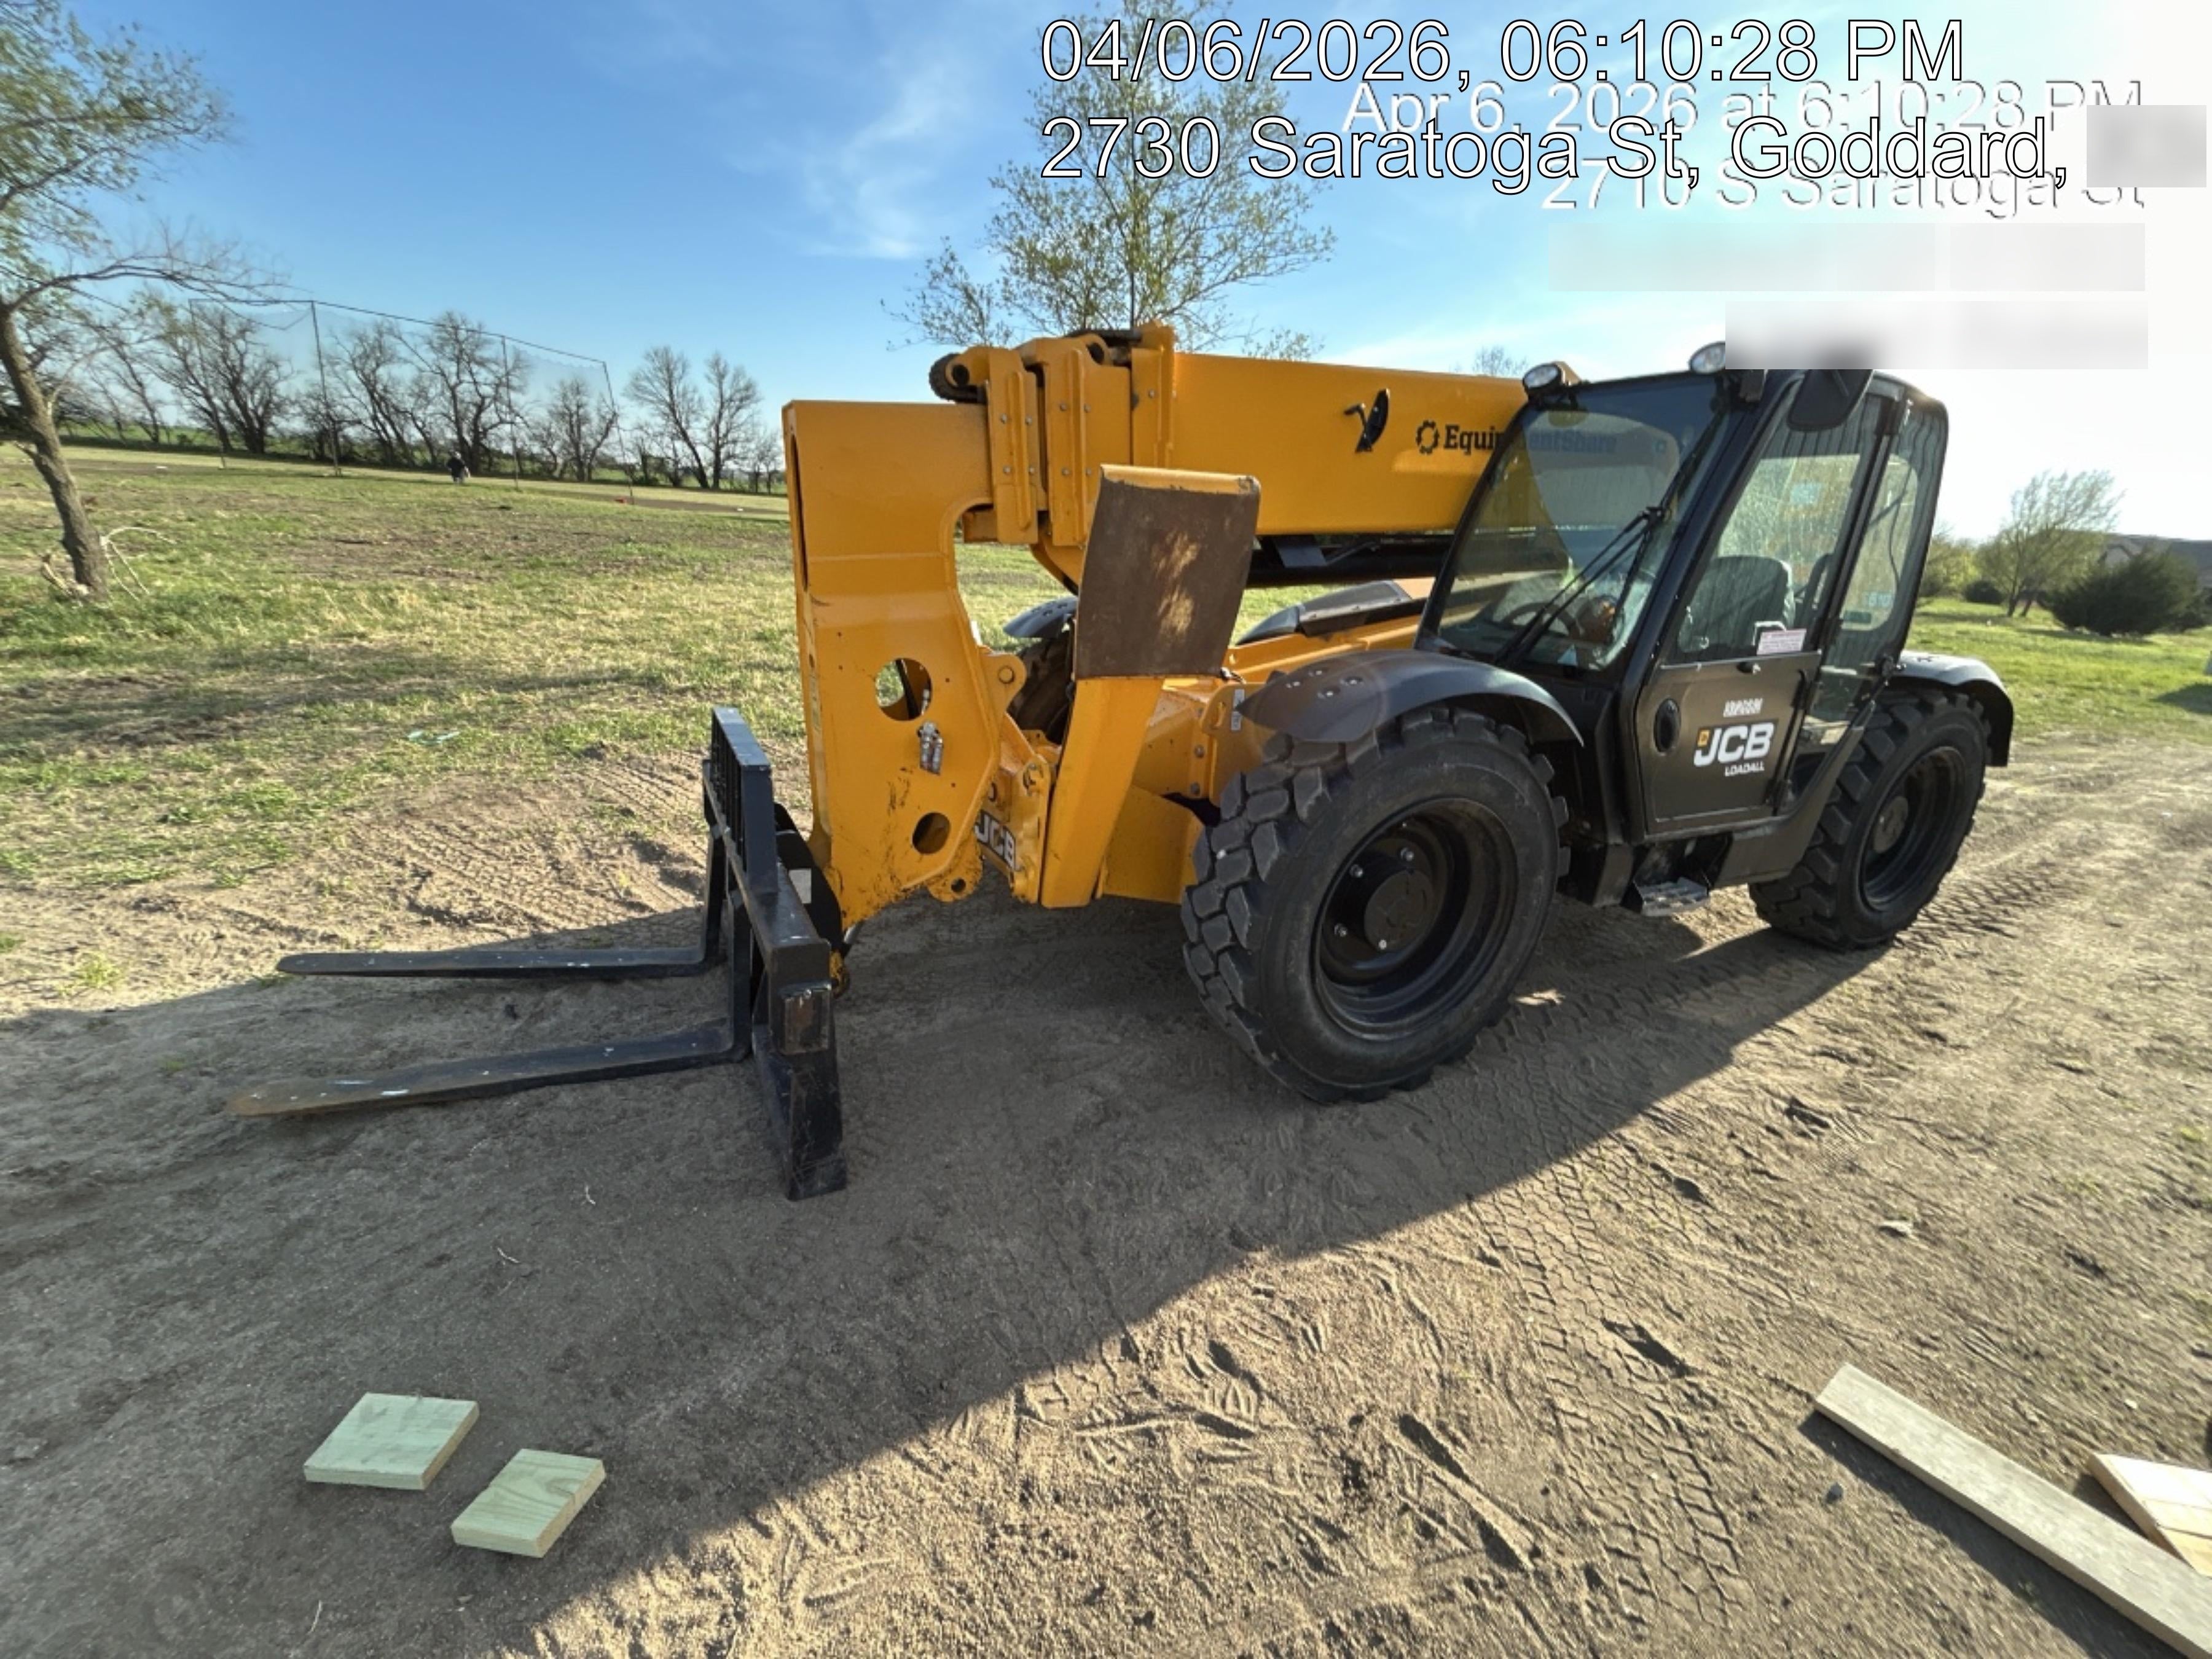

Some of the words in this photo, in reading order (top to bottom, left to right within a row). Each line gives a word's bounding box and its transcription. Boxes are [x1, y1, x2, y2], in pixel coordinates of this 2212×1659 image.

[1694, 722, 1774, 766] JCB
[1725, 761, 1765, 777] LOADALL
[975, 814, 1015, 869] JCB
